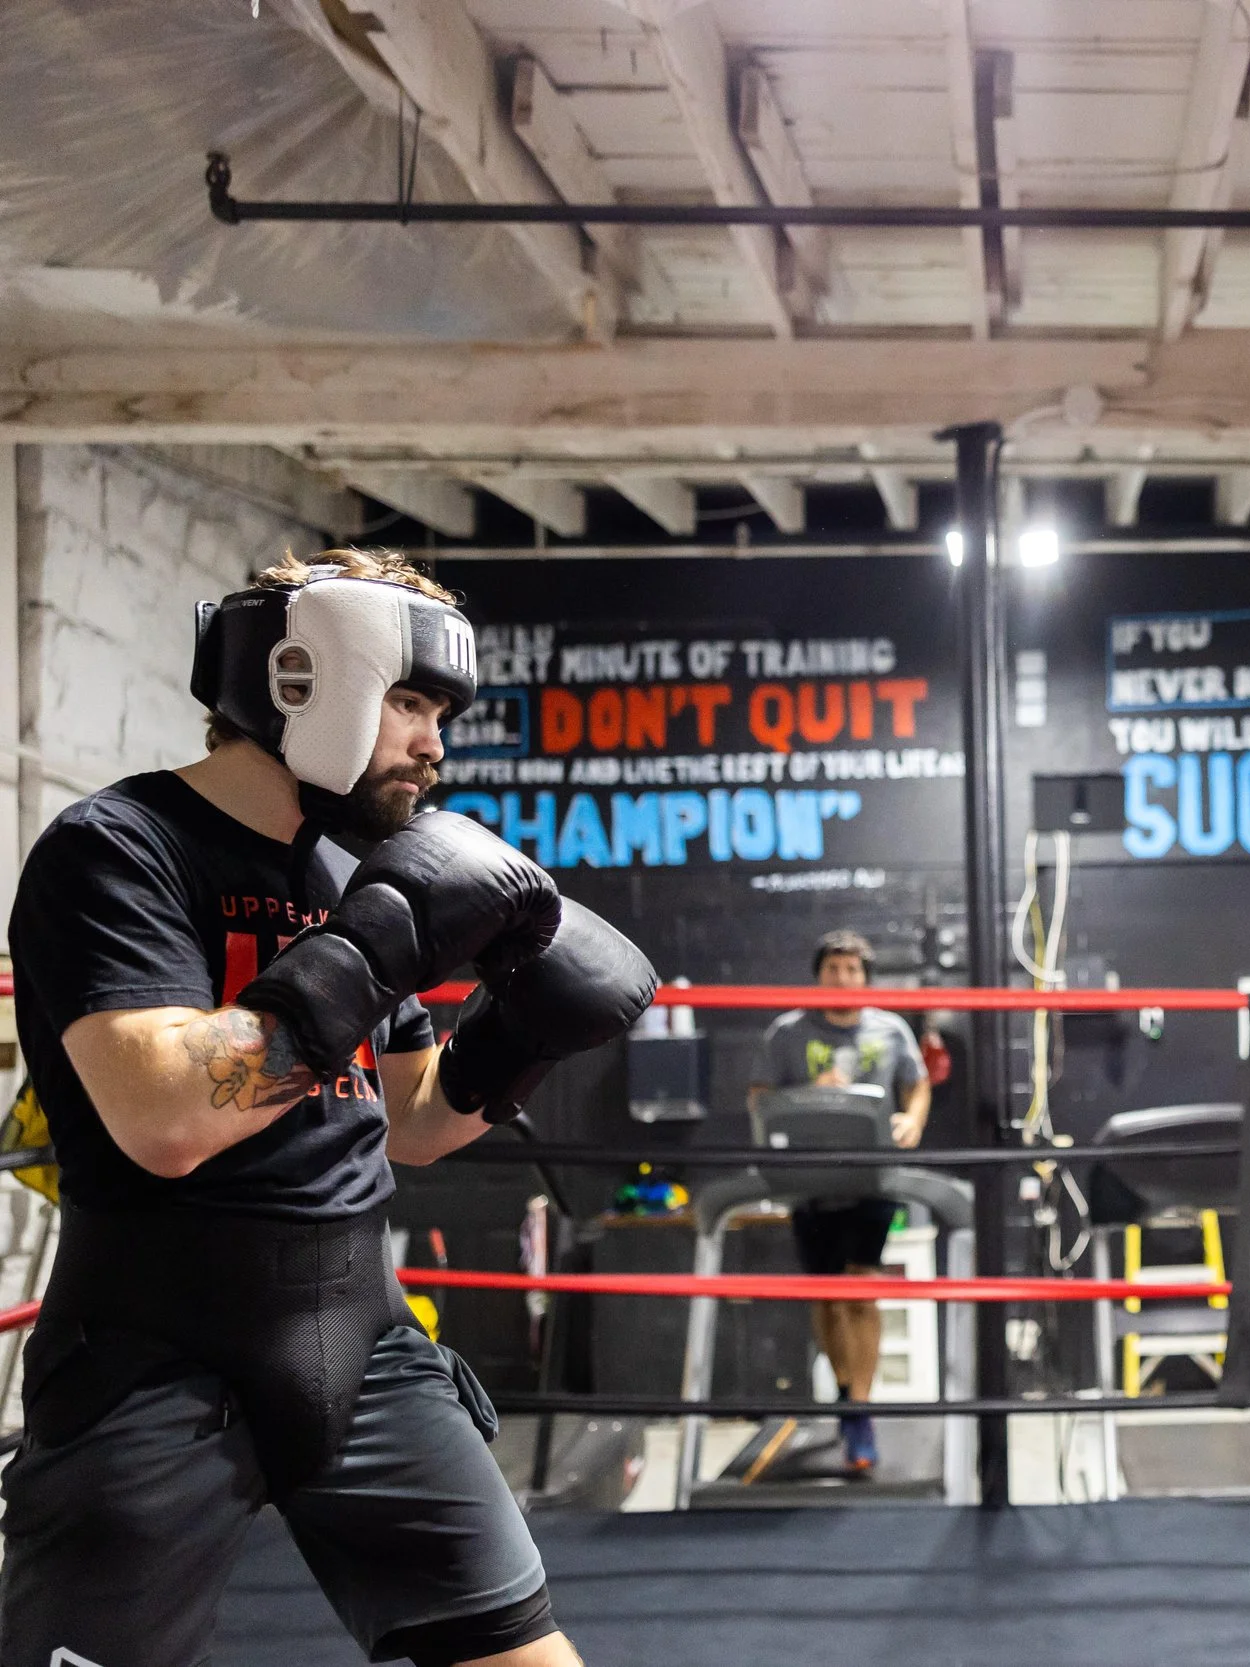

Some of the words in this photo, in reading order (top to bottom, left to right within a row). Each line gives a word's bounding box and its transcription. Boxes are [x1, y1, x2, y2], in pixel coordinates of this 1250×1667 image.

[1147, 618, 1212, 652] YOU
[559, 641, 683, 685] MINUTE
[687, 640, 735, 679] OF
[740, 636, 897, 678] TRAINING
[1112, 666, 1230, 705] NEVER
[540, 683, 733, 756] DON'T
[749, 677, 928, 755] QUIT
[1109, 717, 1177, 755] YOU
